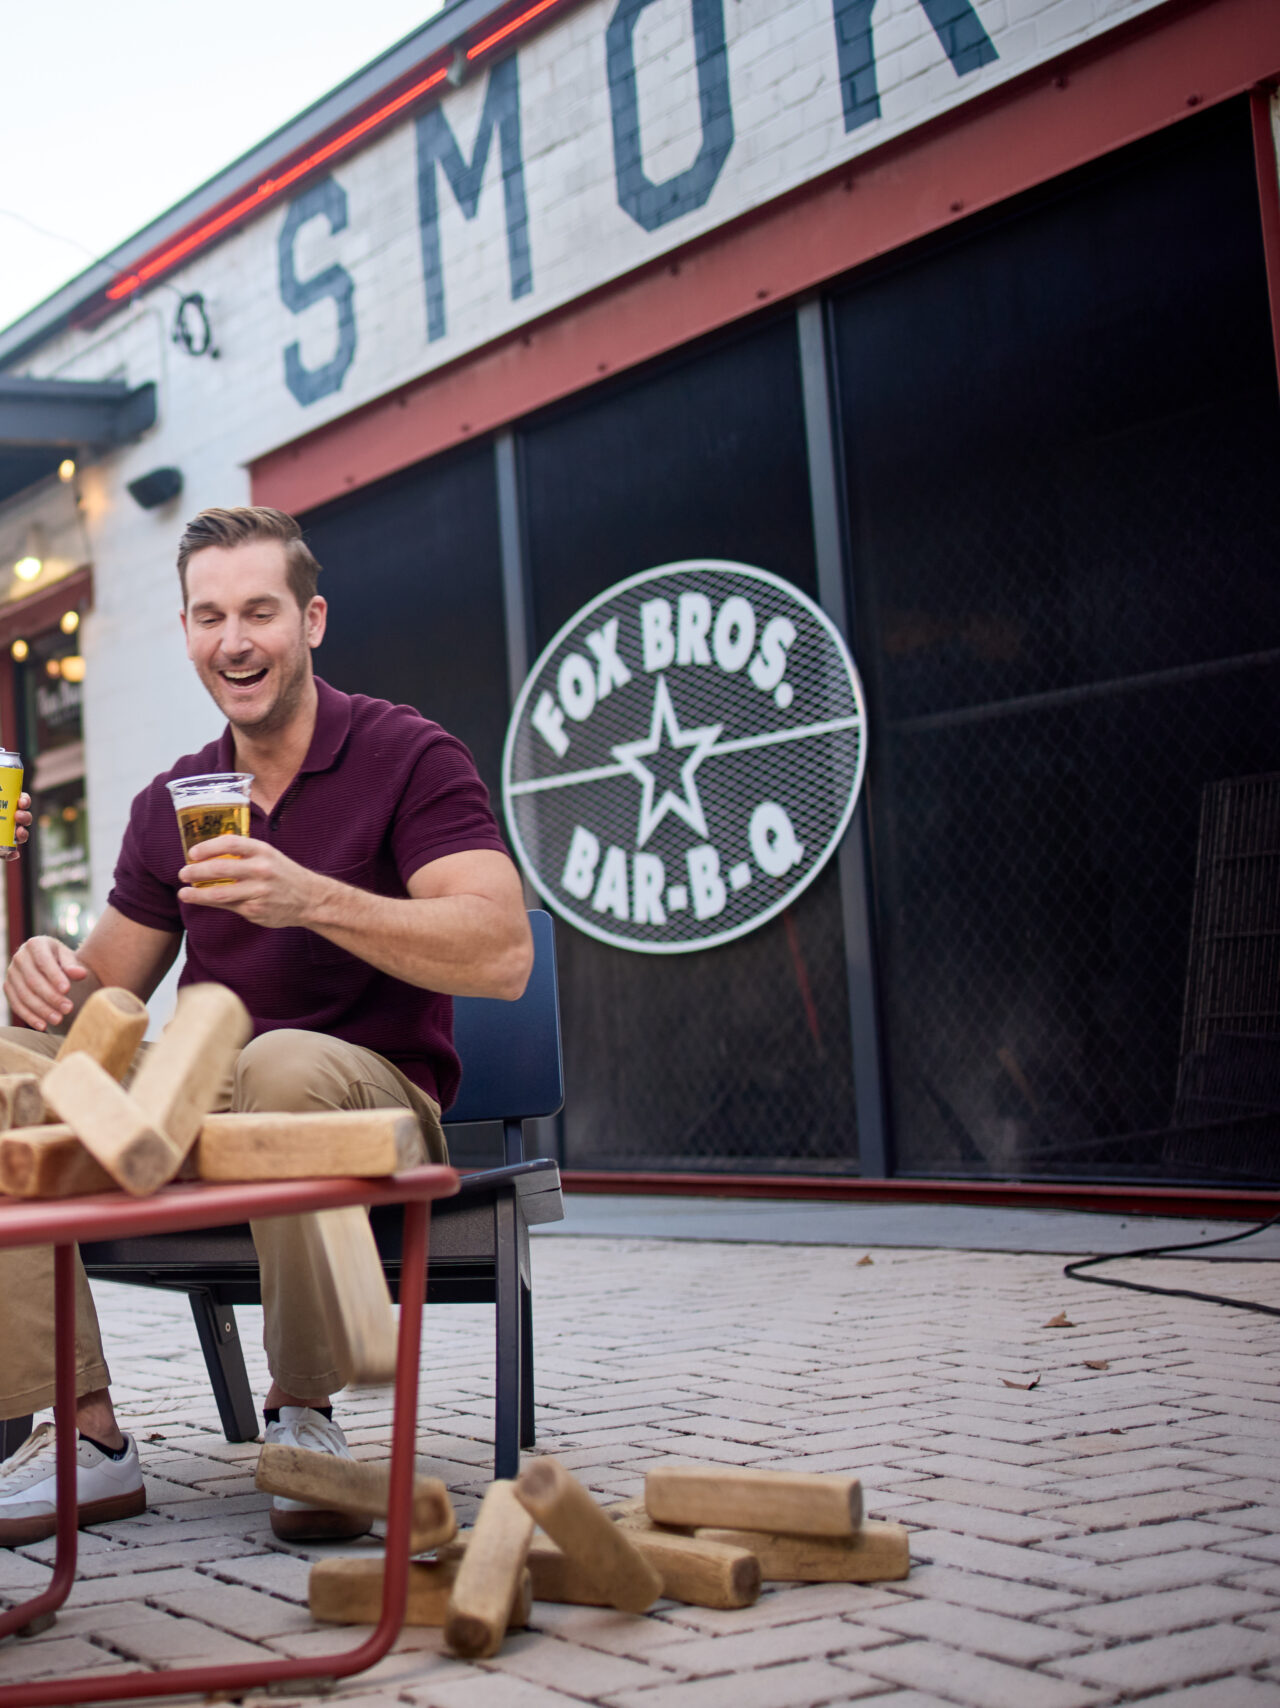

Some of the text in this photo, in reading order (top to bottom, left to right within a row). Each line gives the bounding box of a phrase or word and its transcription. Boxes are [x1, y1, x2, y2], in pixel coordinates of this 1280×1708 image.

[530, 590, 799, 759] FOX BROS.
[560, 800, 805, 926] BAR-B-Q
